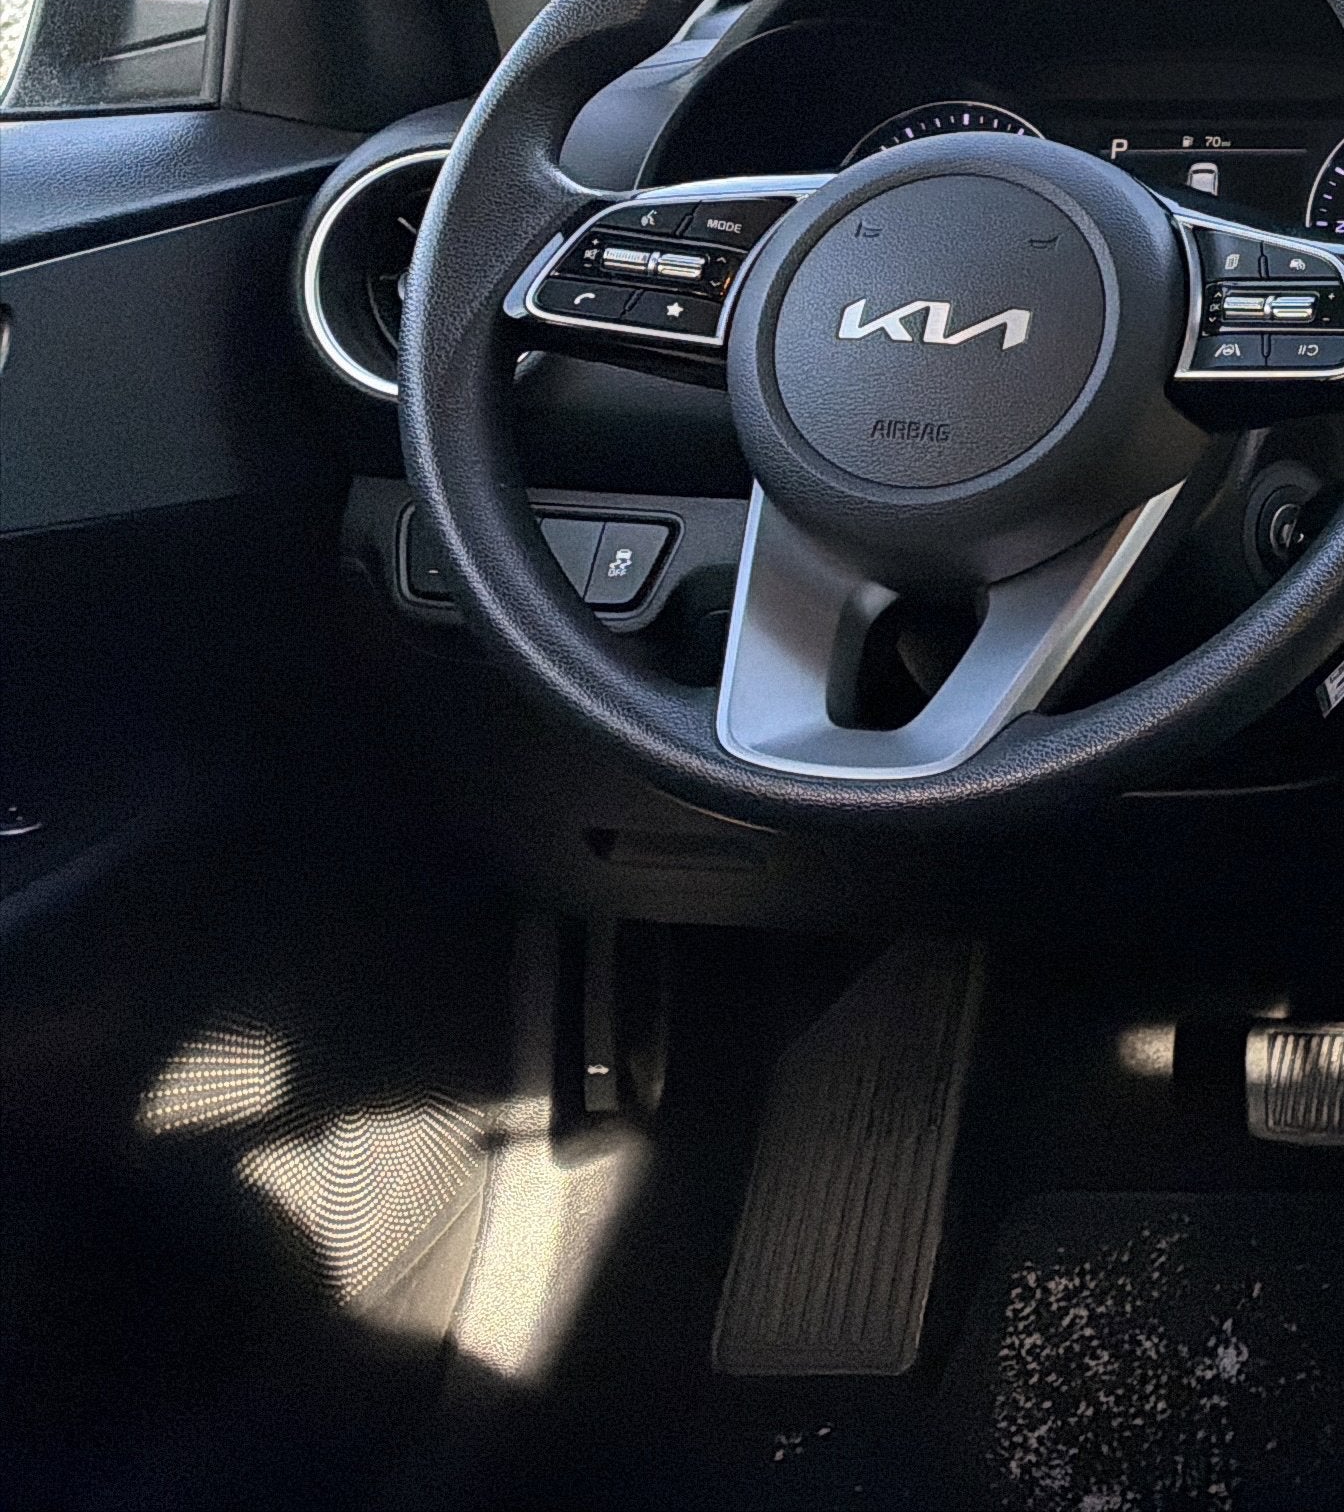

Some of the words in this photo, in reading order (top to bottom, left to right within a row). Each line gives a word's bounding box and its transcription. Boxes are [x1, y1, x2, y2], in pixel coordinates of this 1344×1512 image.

[1111, 139, 1128, 159] P
[707, 218, 742, 234] MODE
[869, 419, 950, 442] AIRBAG
